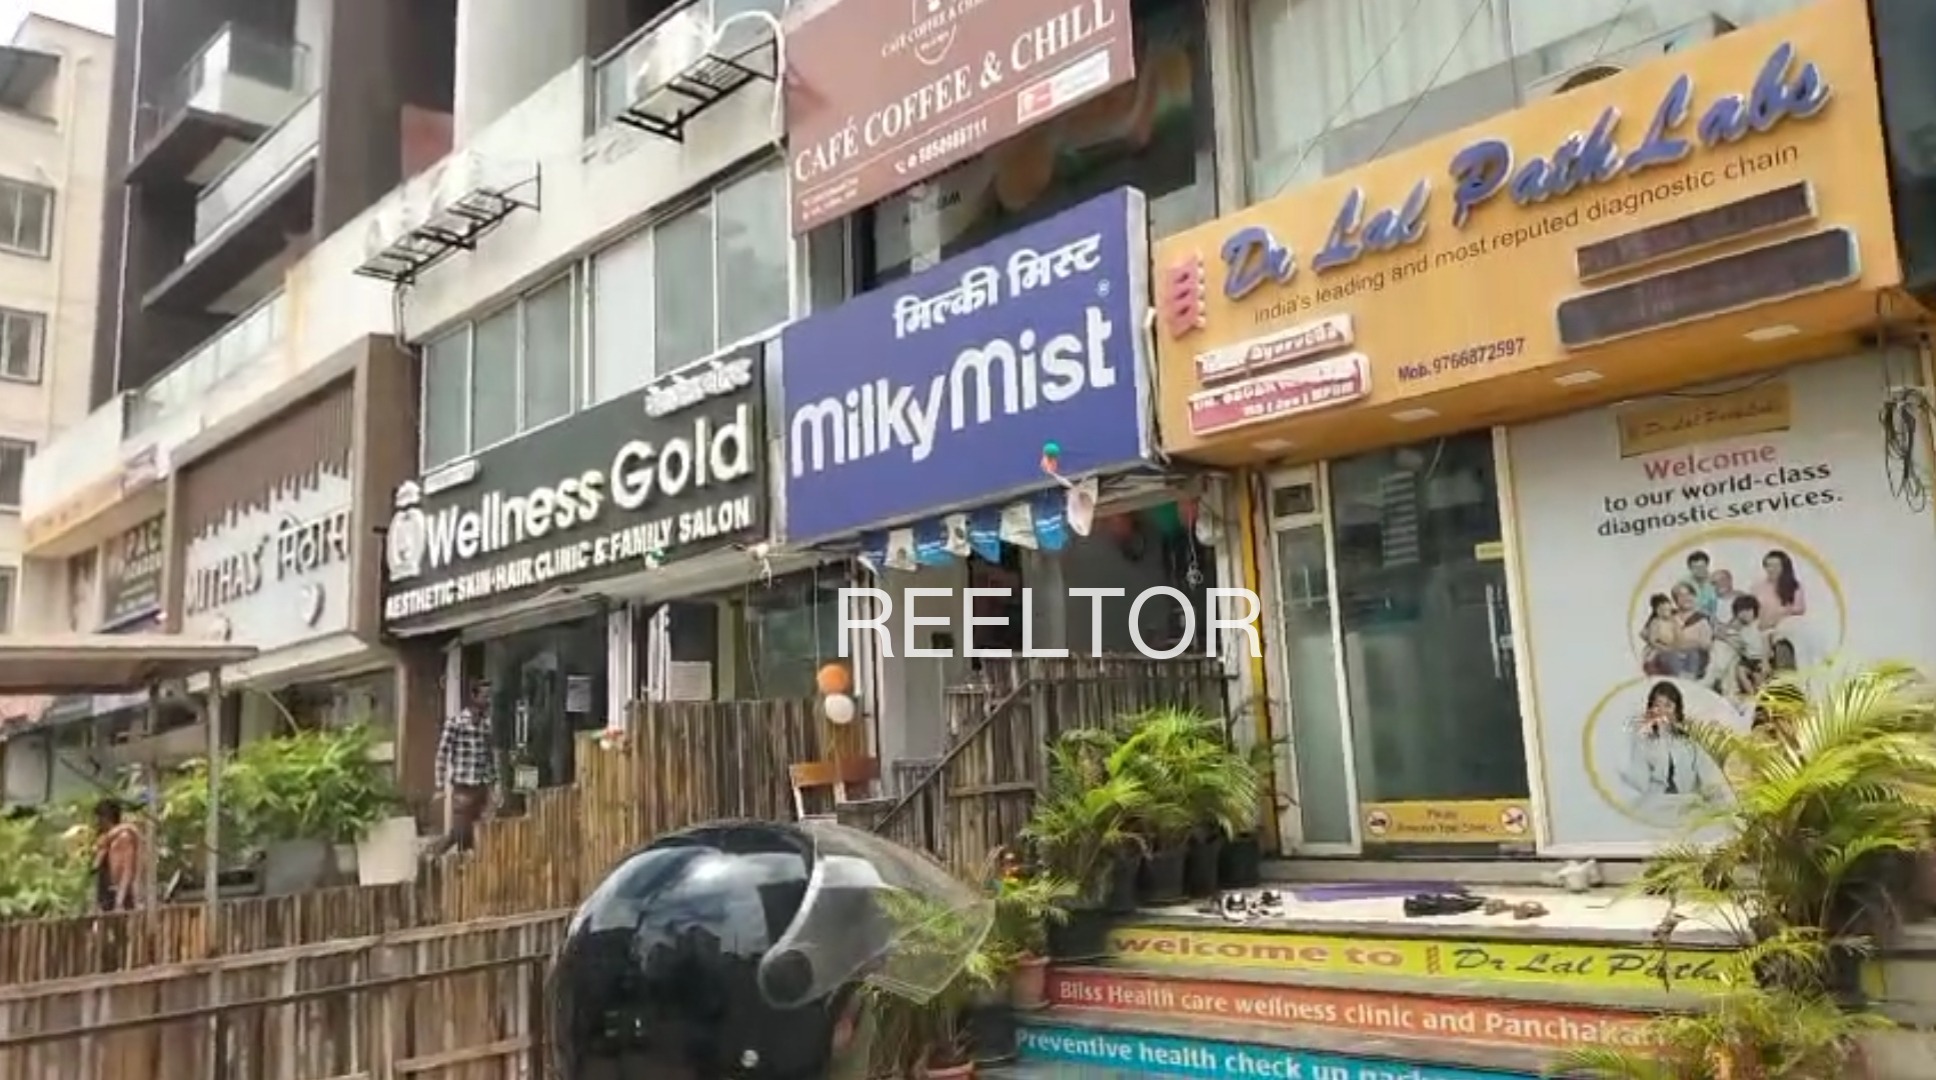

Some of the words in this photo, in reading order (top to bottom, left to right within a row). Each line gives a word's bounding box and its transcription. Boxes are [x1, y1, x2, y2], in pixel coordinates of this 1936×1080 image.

[795, 115, 859, 182] CAFÉ
[864, 64, 973, 147] COFFEE
[979, 50, 1004, 90] &
[1010, 0, 1115, 72] CHILL
[1220, 224, 1297, 299] Dr
[1311, 176, 1432, 275] Lal
[1316, 271, 1384, 303] leading
[1390, 252, 1429, 281] and
[1435, 240, 1487, 266] most
[1491, 208, 1579, 250] reputed
[1586, 169, 1716, 222] diagnostic
[1723, 143, 1799, 181] chain
[892, 265, 1000, 339] मिल्की
[1006, 233, 1102, 298] मिस्ट
[427, 468, 606, 569] Wellness
[611, 402, 752, 510] Gold
[1604, 495, 1628, 513] to
[1635, 489, 1676, 508] our
[1680, 461, 1832, 499] world-class
[1643, 444, 1777, 481] Welcome
[1597, 504, 1721, 537] diagnostic
[1727, 487, 1844, 518] services.
[385, 578, 456, 620] AESTHETIC
[536, 541, 593, 582] CLINIC
[610, 516, 673, 562] FAMILY
[678, 495, 750, 543] SALON
[1113, 937, 1329, 963] welcome
[1345, 946, 1403, 967] to
[1453, 948, 1507, 972] Dr
[1515, 951, 1594, 975] Lal
[1607, 952, 1724, 983] Path
[1060, 981, 1103, 1001] Bliss
[1108, 985, 1174, 1008] Health
[1181, 994, 1229, 1012] care
[1234, 995, 1338, 1022] wellness
[1344, 1001, 1413, 1029] clinic
[1422, 1009, 1476, 1033] and
[1015, 1029, 1132, 1059] Preventive
[1139, 1043, 1216, 1072] health
[1224, 1051, 1302, 1079] check
